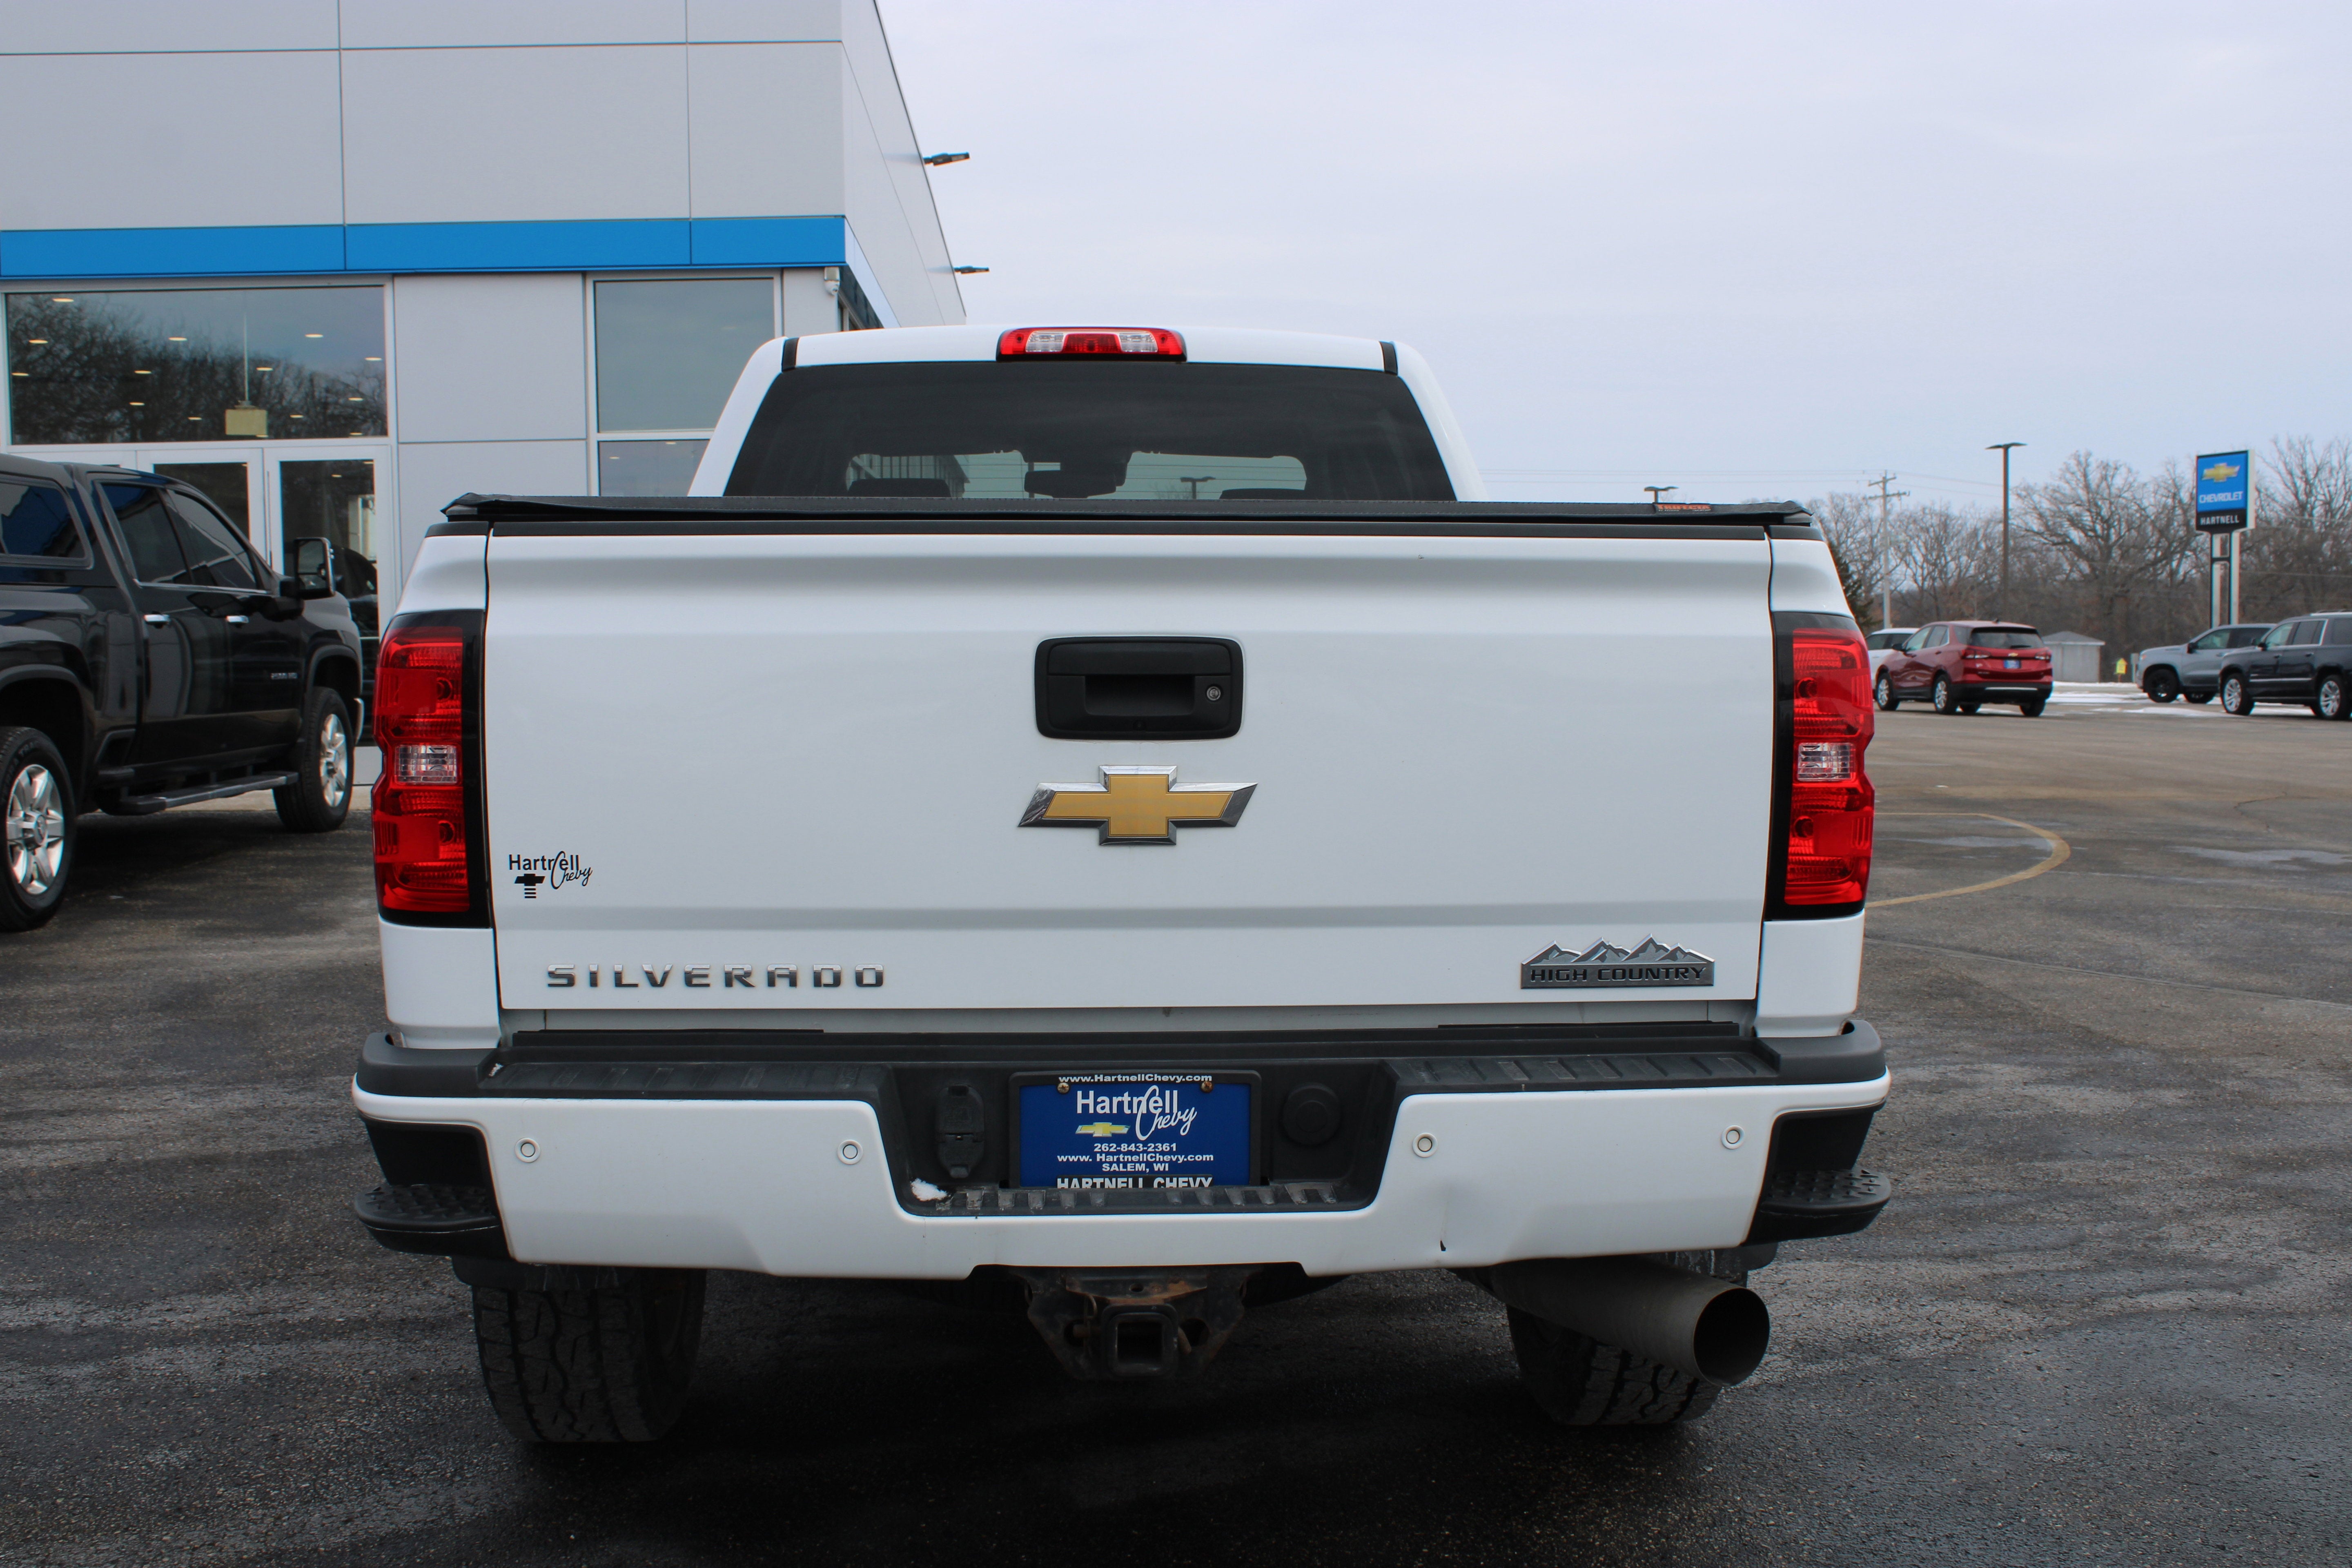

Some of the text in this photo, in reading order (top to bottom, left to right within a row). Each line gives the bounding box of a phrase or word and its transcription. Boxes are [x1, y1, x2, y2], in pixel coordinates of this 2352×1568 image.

[2200, 492, 2243, 503] CHEVROLET
[2201, 515, 2240, 525] HARTNELL
[551, 851, 593, 889] Chevy
[547, 963, 884, 988] SILVERADO
[1530, 967, 1707, 982] HIGH COUNTRY
[1058, 1074, 1212, 1083] www.HartnellChevy.com
[1077, 1090, 1178, 1114] Hartnell
[1135, 1085, 1198, 1141] Chevy
[1094, 1143, 1177, 1152] 262-843-2361
[1102, 1163, 1169, 1173] SALEM, WI
